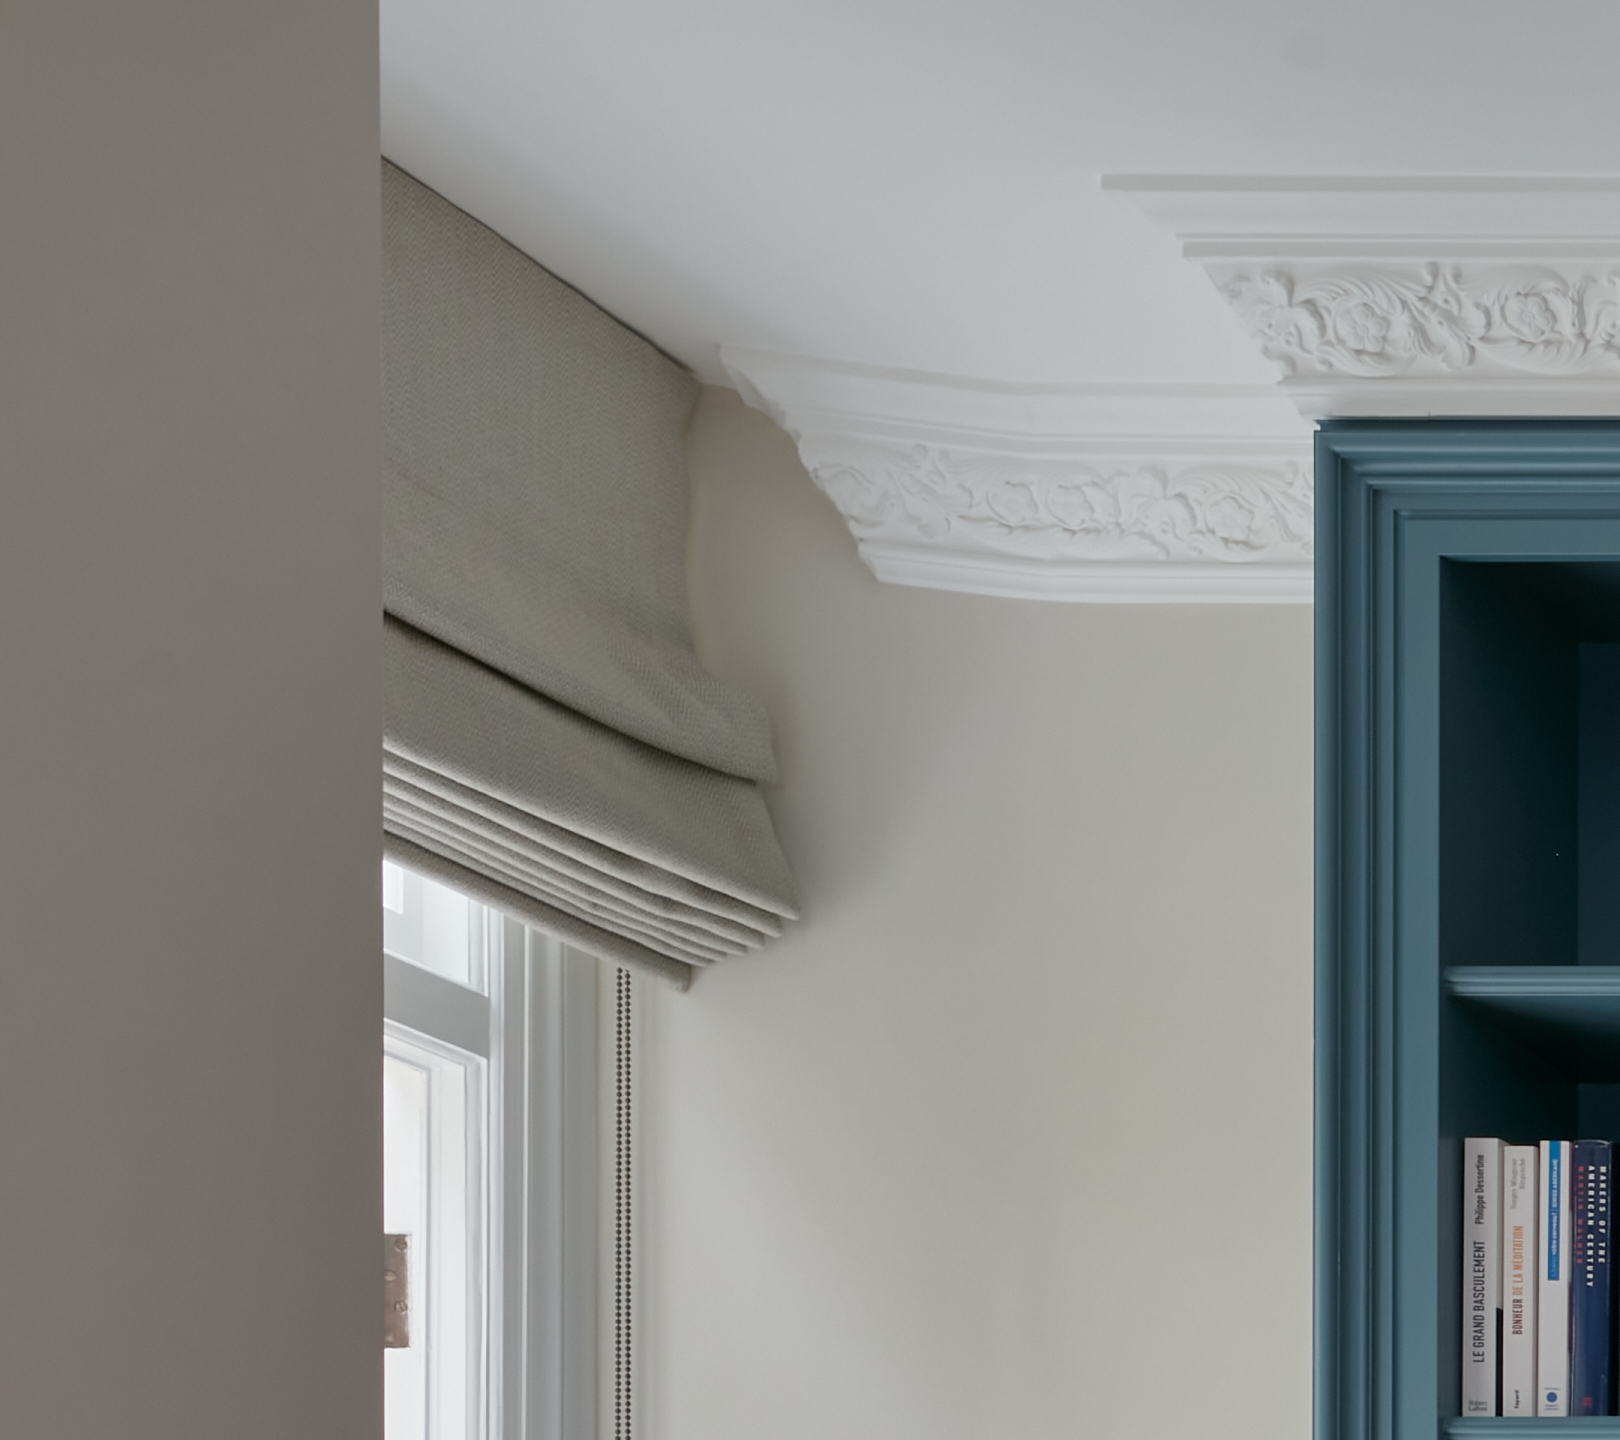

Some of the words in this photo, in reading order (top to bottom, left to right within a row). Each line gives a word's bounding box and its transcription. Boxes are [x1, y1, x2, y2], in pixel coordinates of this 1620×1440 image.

[1587, 1166, 1595, 1226] AMERICAN
[1599, 1221, 1606, 1234] OF
[1511, 1226, 1523, 1270] MÉDITATION
[1473, 1240, 1485, 1311] BASCULEMENT
[1513, 1273, 1523, 1283] LA
[1513, 1286, 1523, 1295] DE
[1473, 1315, 1485, 1347] GRAND
[1512, 1299, 1523, 1334] BONHEUR
[1473, 1351, 1485, 1363] LE
